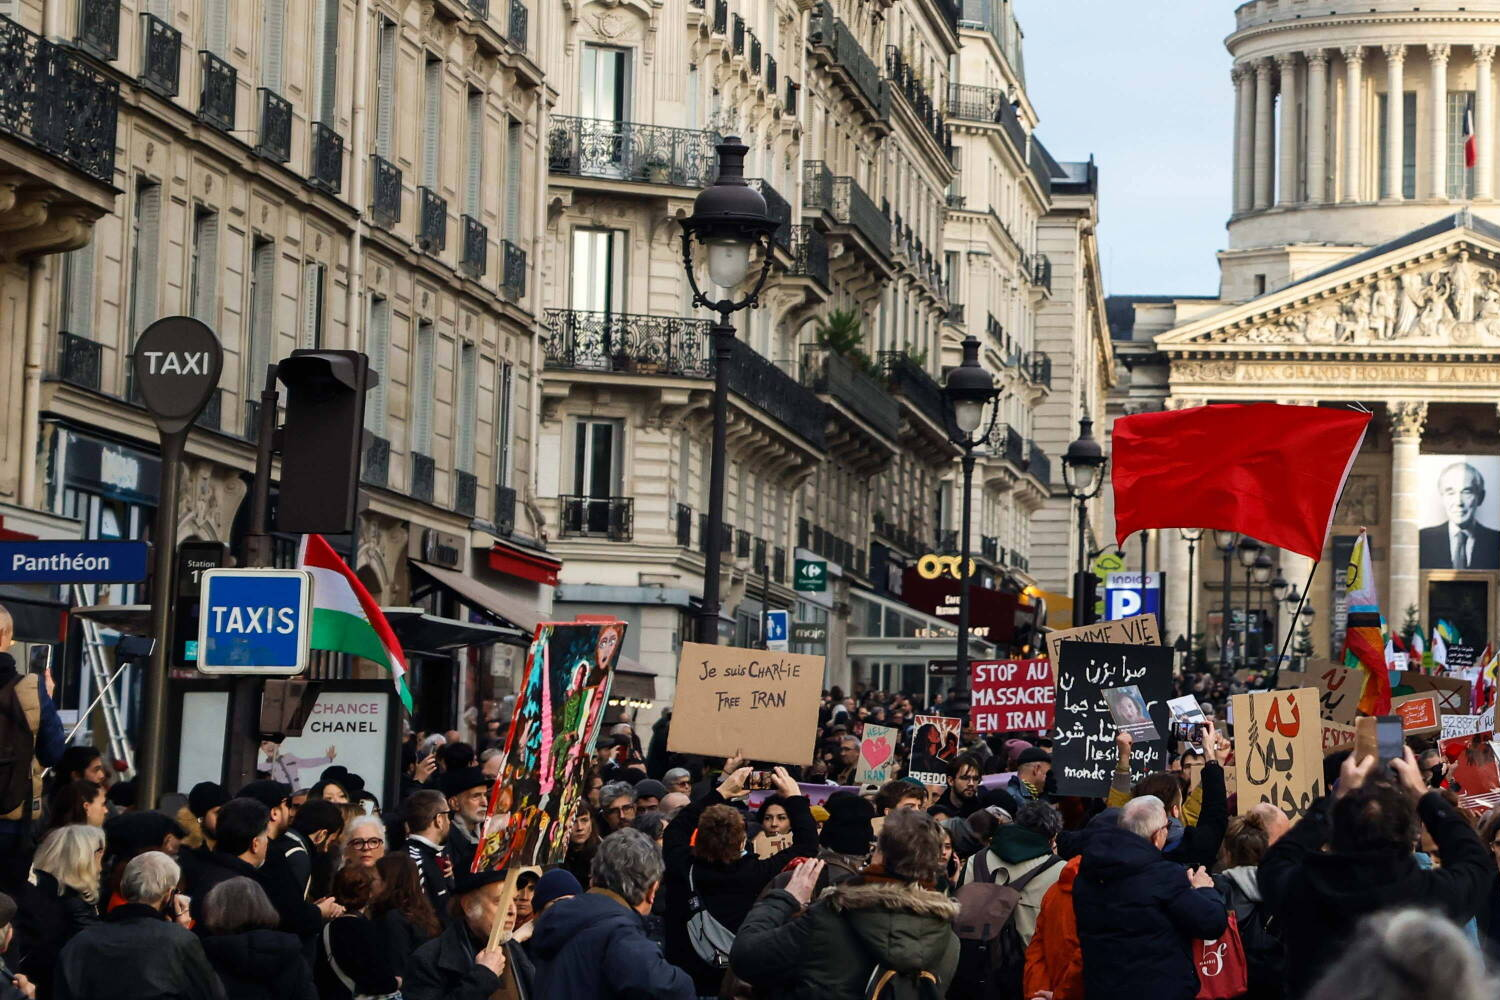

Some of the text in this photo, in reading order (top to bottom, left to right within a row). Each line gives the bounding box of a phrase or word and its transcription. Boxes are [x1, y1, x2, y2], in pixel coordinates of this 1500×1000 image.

[144, 351, 209, 376] TAXI
[1242, 366, 1275, 380] AUX
[1282, 366, 1351, 380] GRANDS
[1355, 367, 1427, 380] HOMMES
[1438, 367, 1458, 382] LA
[12, 553, 110, 572] Panthéon
[187, 560, 215, 568] Station
[1112, 590, 1141, 620] P
[212, 606, 295, 635] TAXIS
[1121, 618, 1154, 642] VIE
[699, 660, 717, 681] Je
[723, 664, 746, 677] suis
[975, 662, 1048, 683] STOP AU
[1122, 656, 1147, 682] صدا
[715, 690, 787, 713] FREE IRAN
[972, 685, 1054, 707] MASSACRE
[312, 703, 379, 715] CHANCE
[1265, 693, 1300, 738] نه
[310, 722, 378, 733] CHANEL
[976, 710, 1046, 732] EN IRAN
[864, 770, 885, 781] IRAN
[1064, 763, 1106, 780] monde
